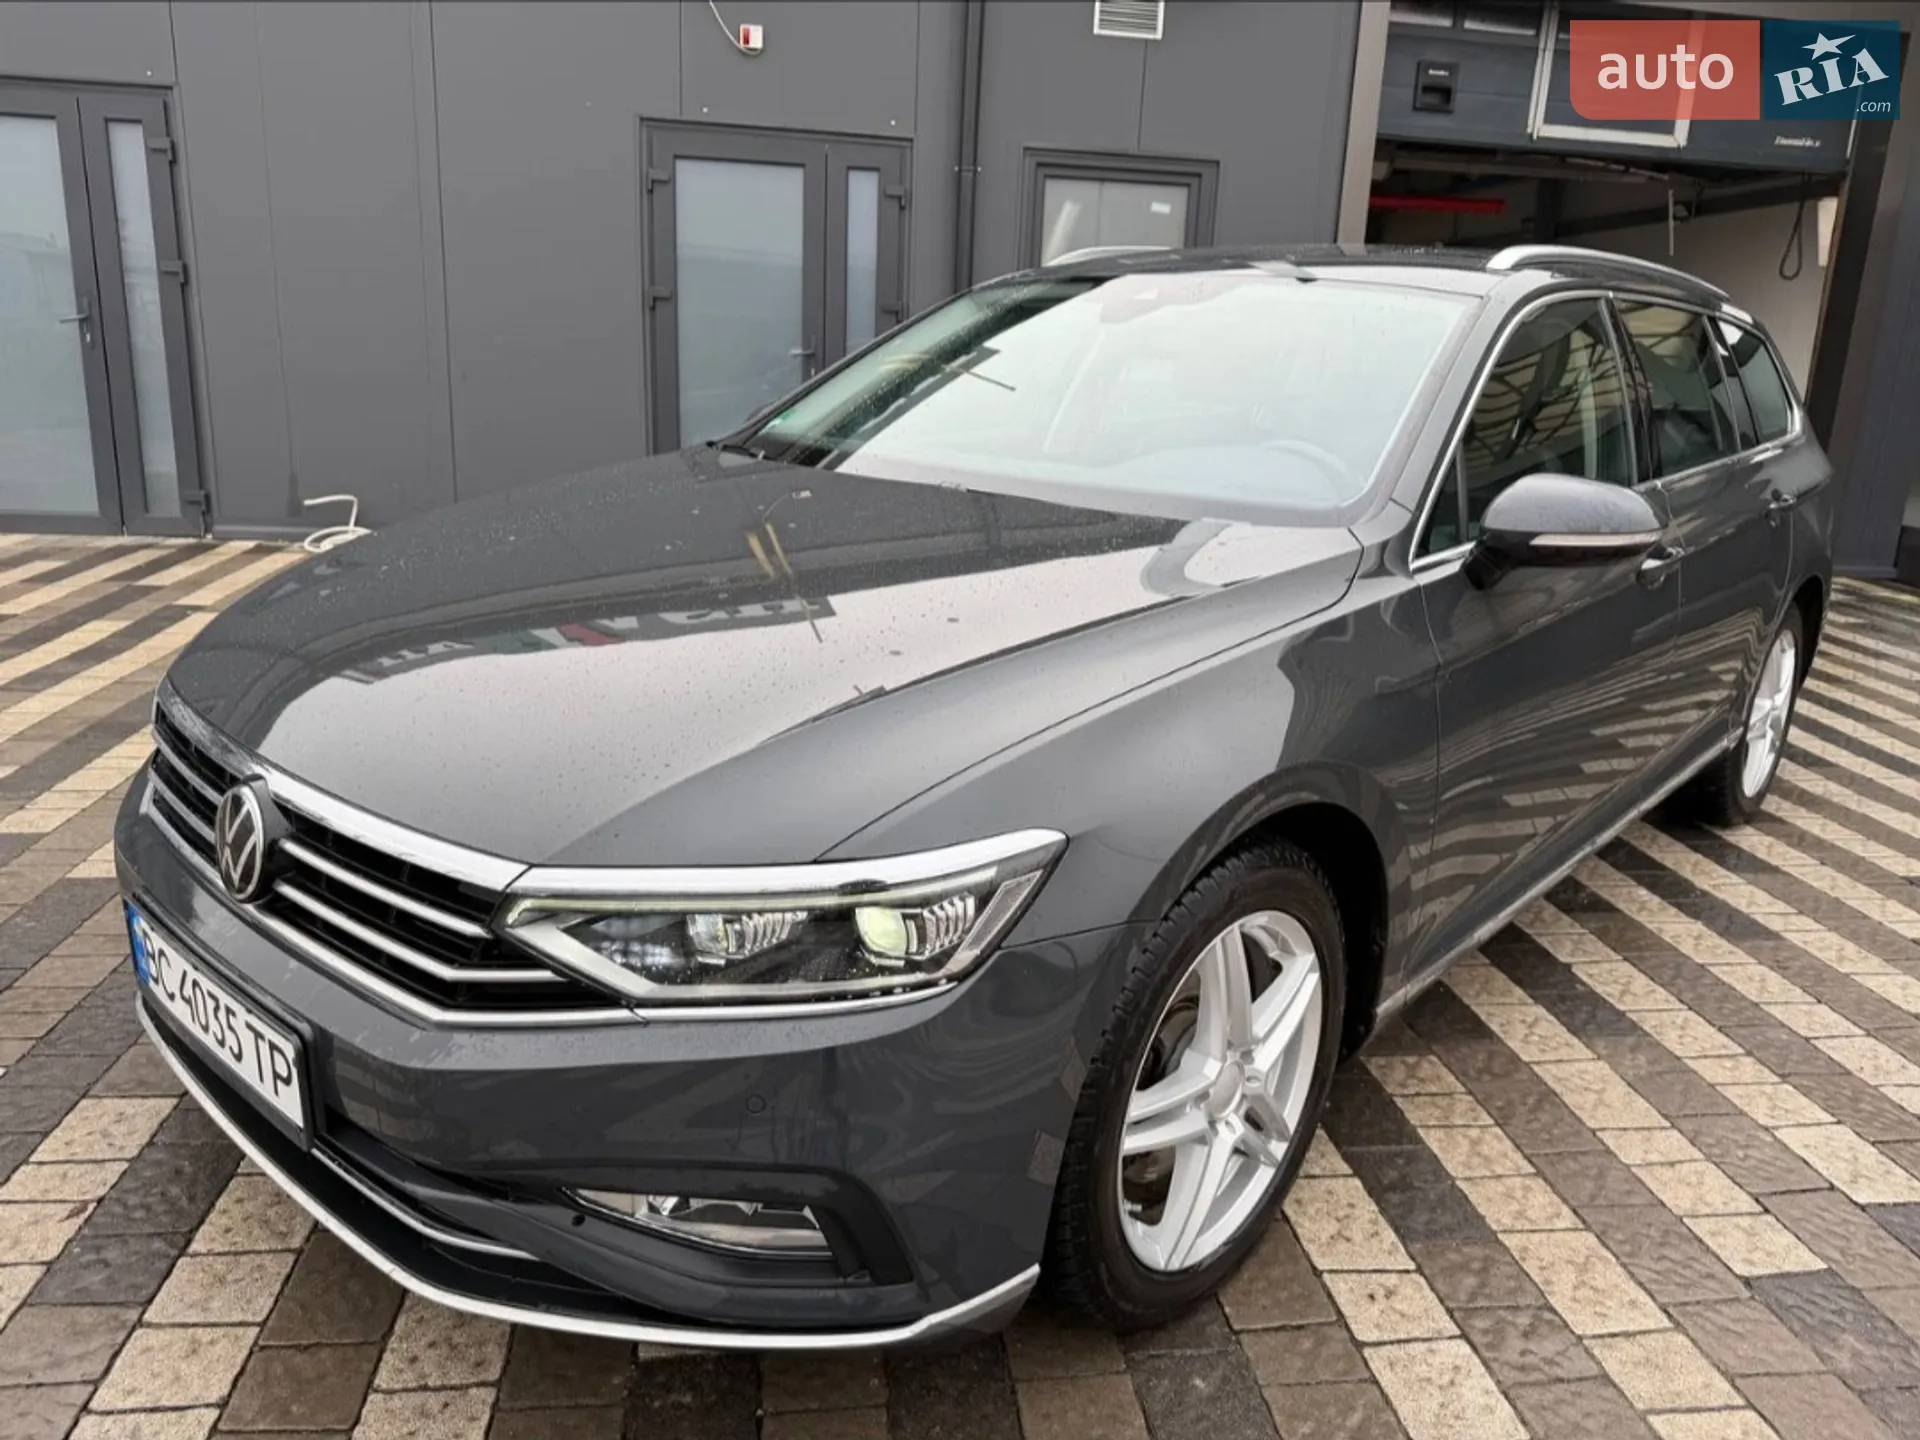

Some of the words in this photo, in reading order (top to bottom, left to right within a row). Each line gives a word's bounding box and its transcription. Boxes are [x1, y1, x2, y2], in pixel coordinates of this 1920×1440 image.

[142, 927, 175, 1003] BC
[179, 969, 243, 1064] 4035
[245, 1020, 293, 1097] TP
